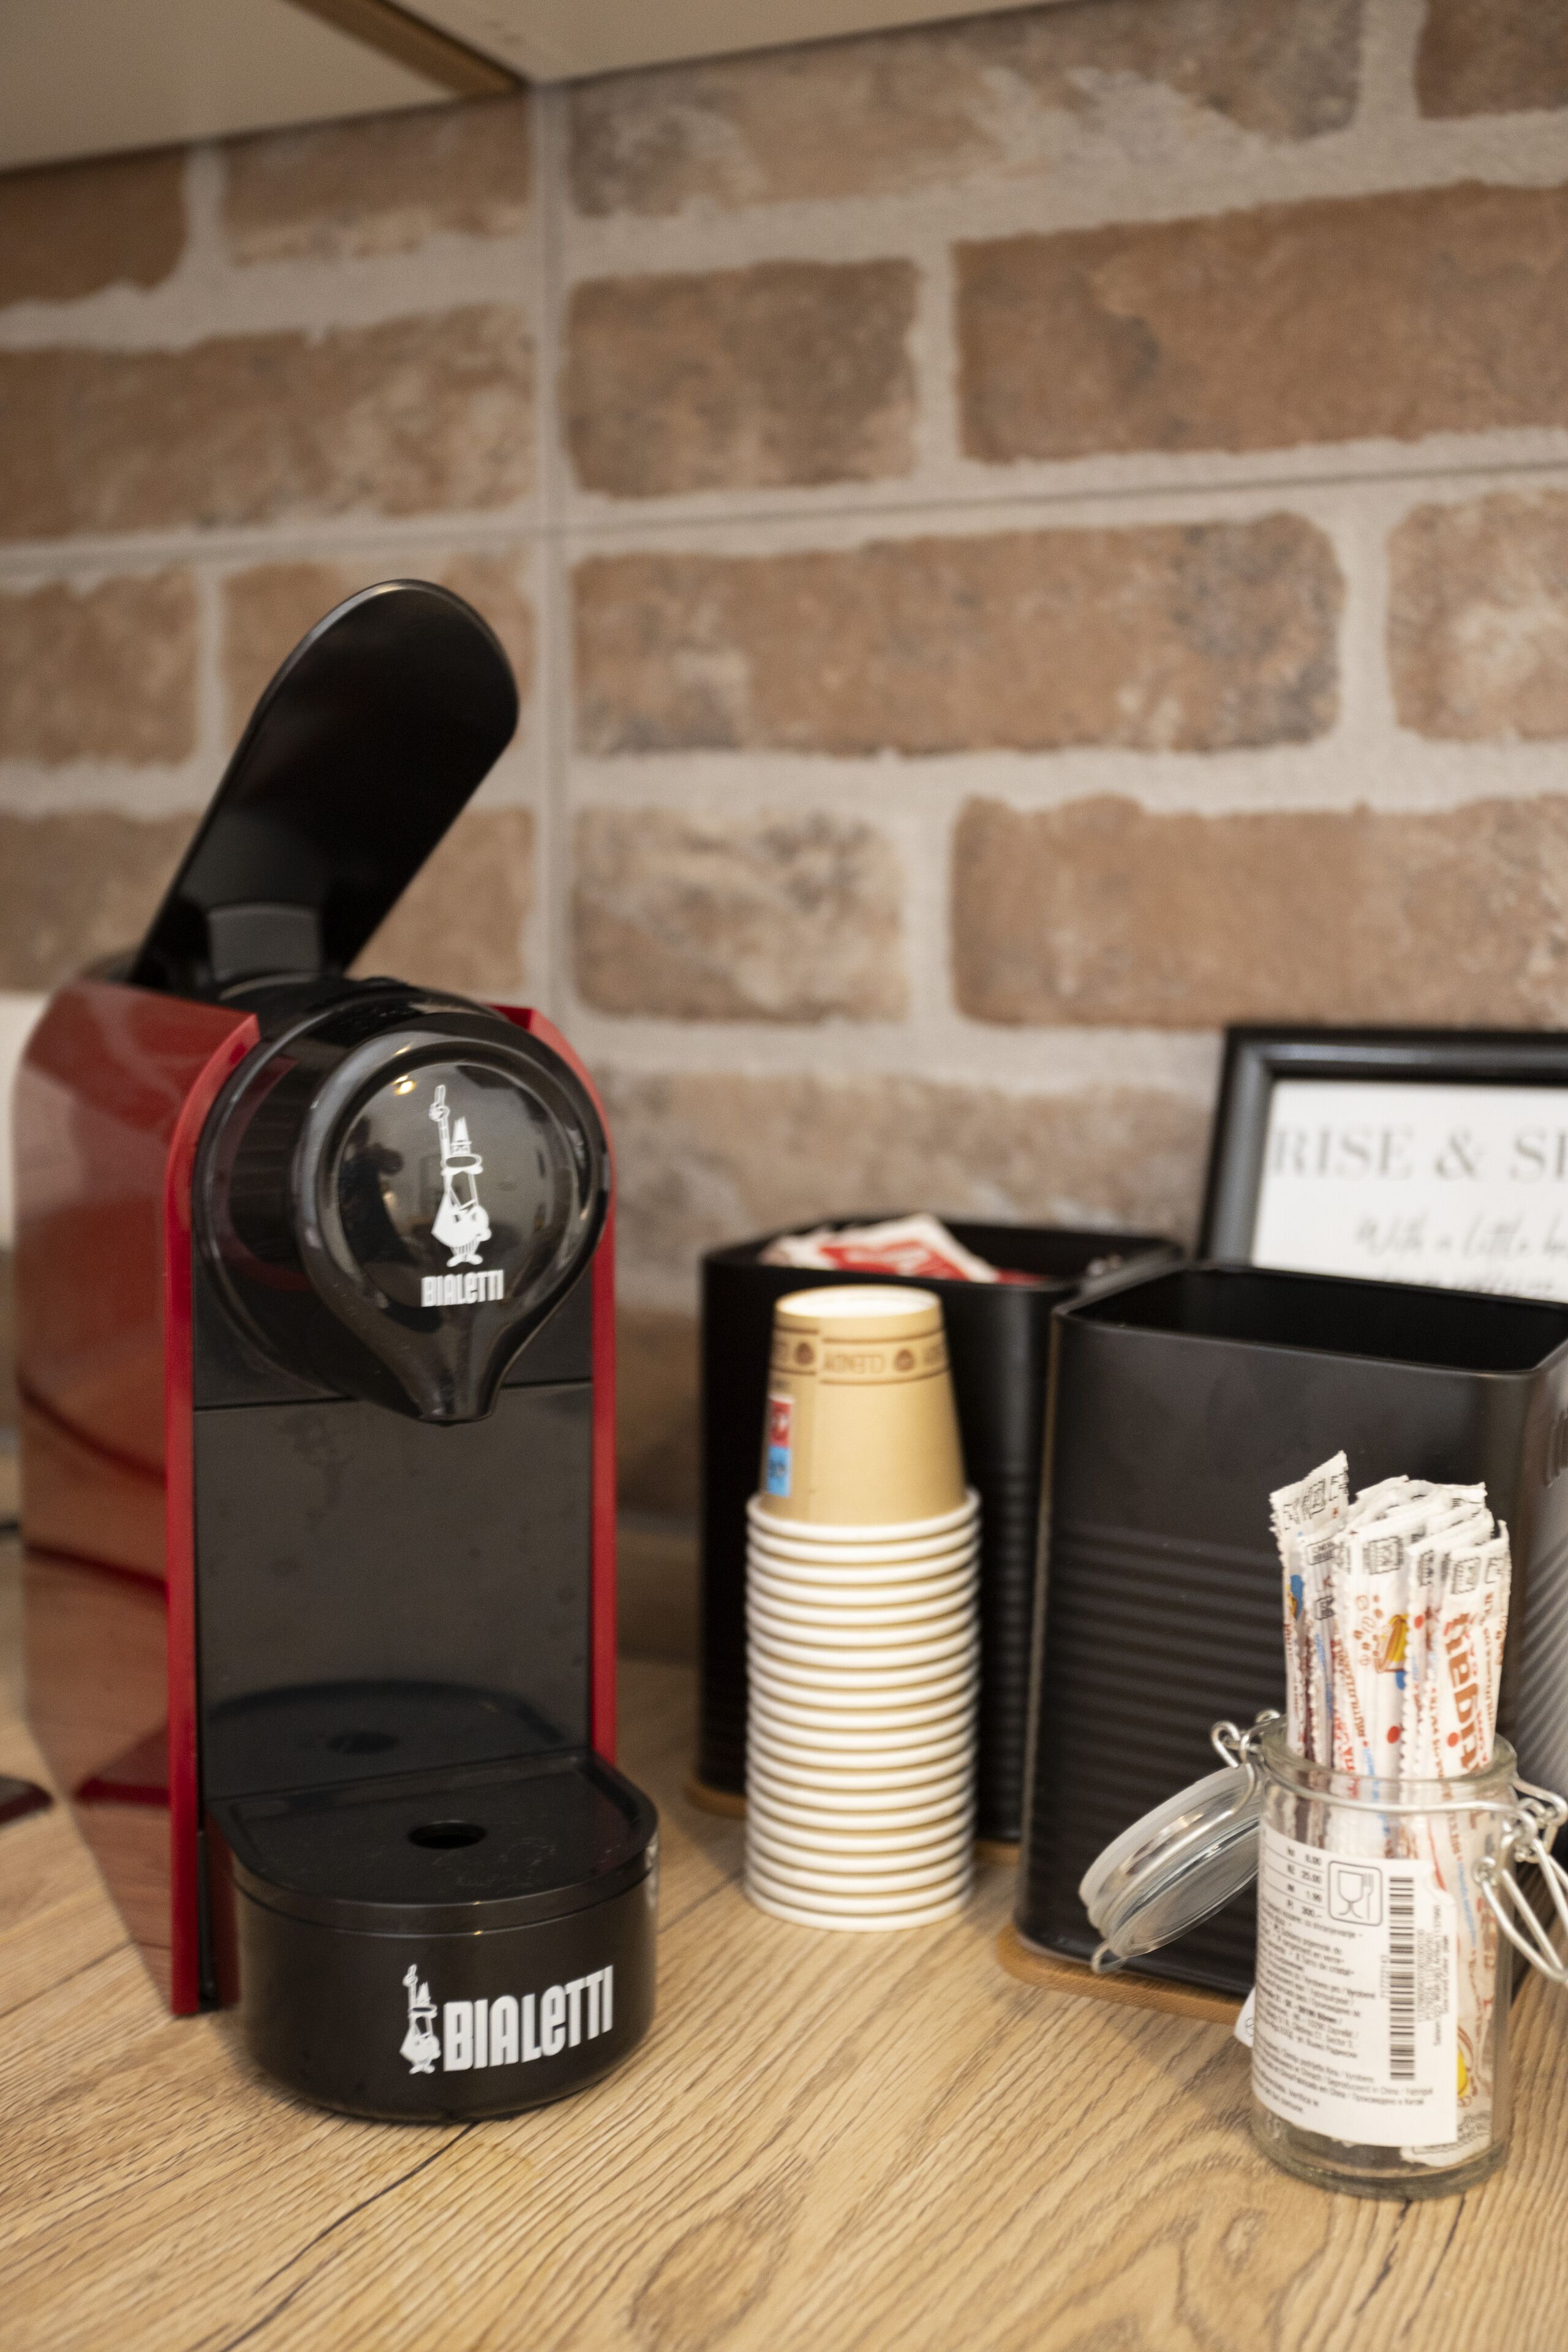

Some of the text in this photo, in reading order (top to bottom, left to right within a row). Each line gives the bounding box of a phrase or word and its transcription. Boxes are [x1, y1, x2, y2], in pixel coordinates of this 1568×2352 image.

[1267, 1122, 1412, 1180] RISE
[1434, 1125, 1483, 1181] &
[443, 1964, 613, 2072] BIALETTI
